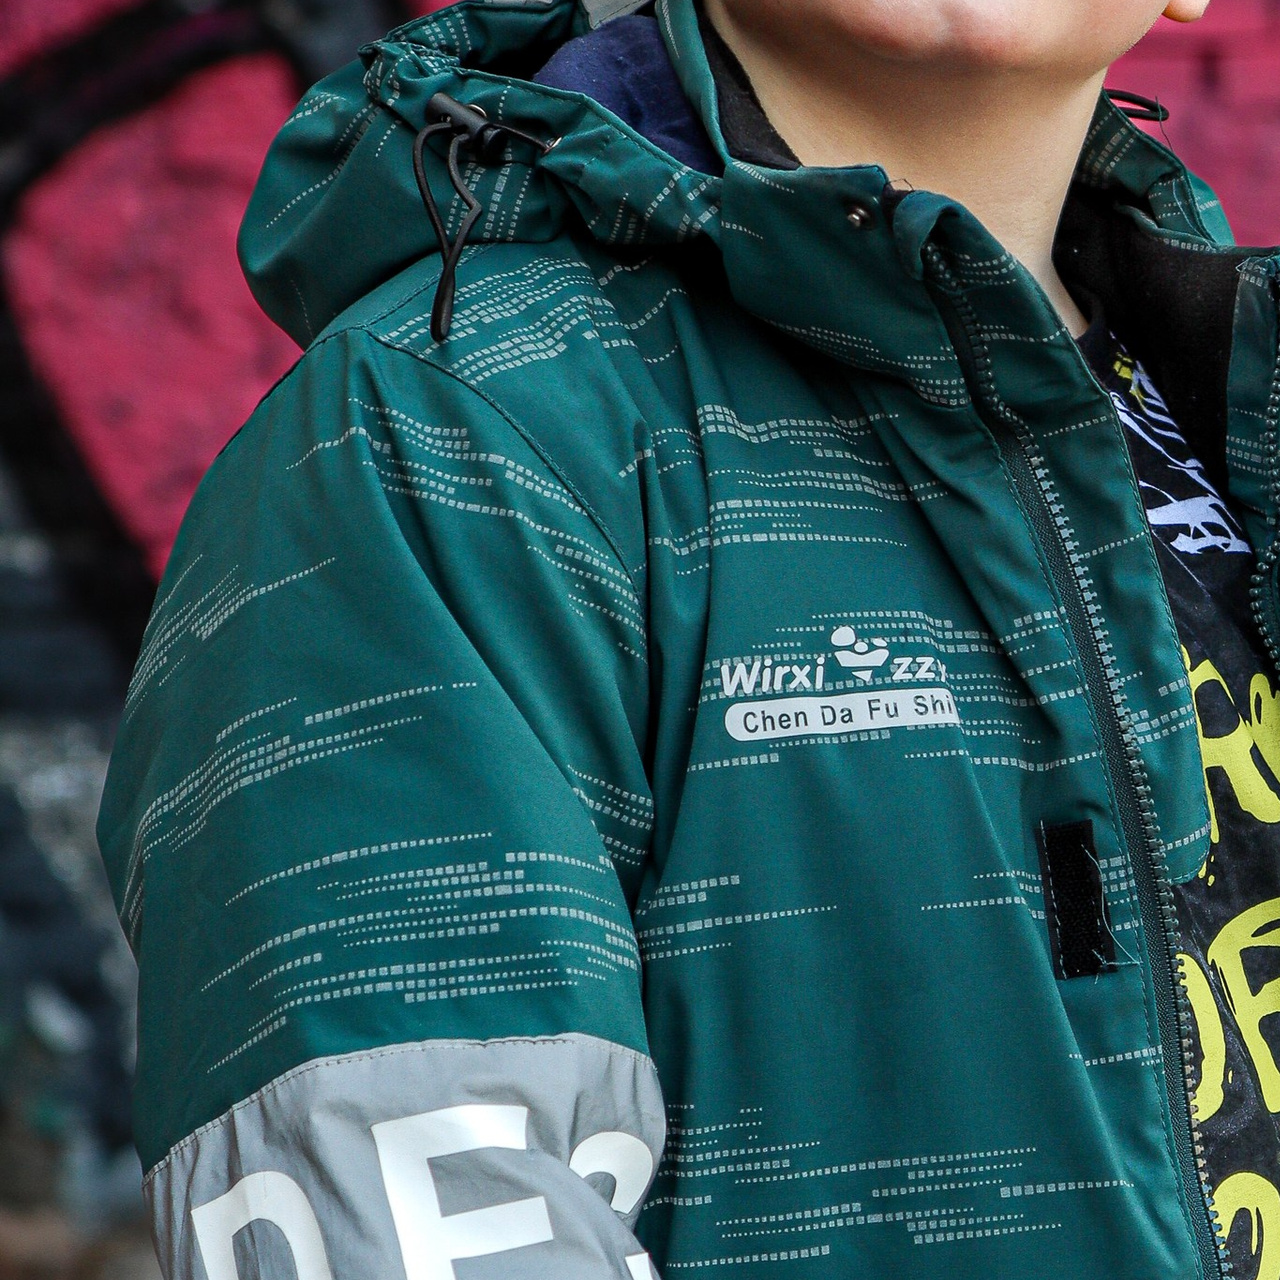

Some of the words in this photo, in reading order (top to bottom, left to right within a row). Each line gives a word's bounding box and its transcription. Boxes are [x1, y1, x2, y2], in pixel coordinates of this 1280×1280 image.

[720, 656, 825, 697] Wirxi
[743, 710, 808, 734] Chen
[820, 705, 854, 726] Da
[867, 698, 900, 720] Fu
[914, 693, 953, 716] Shi
